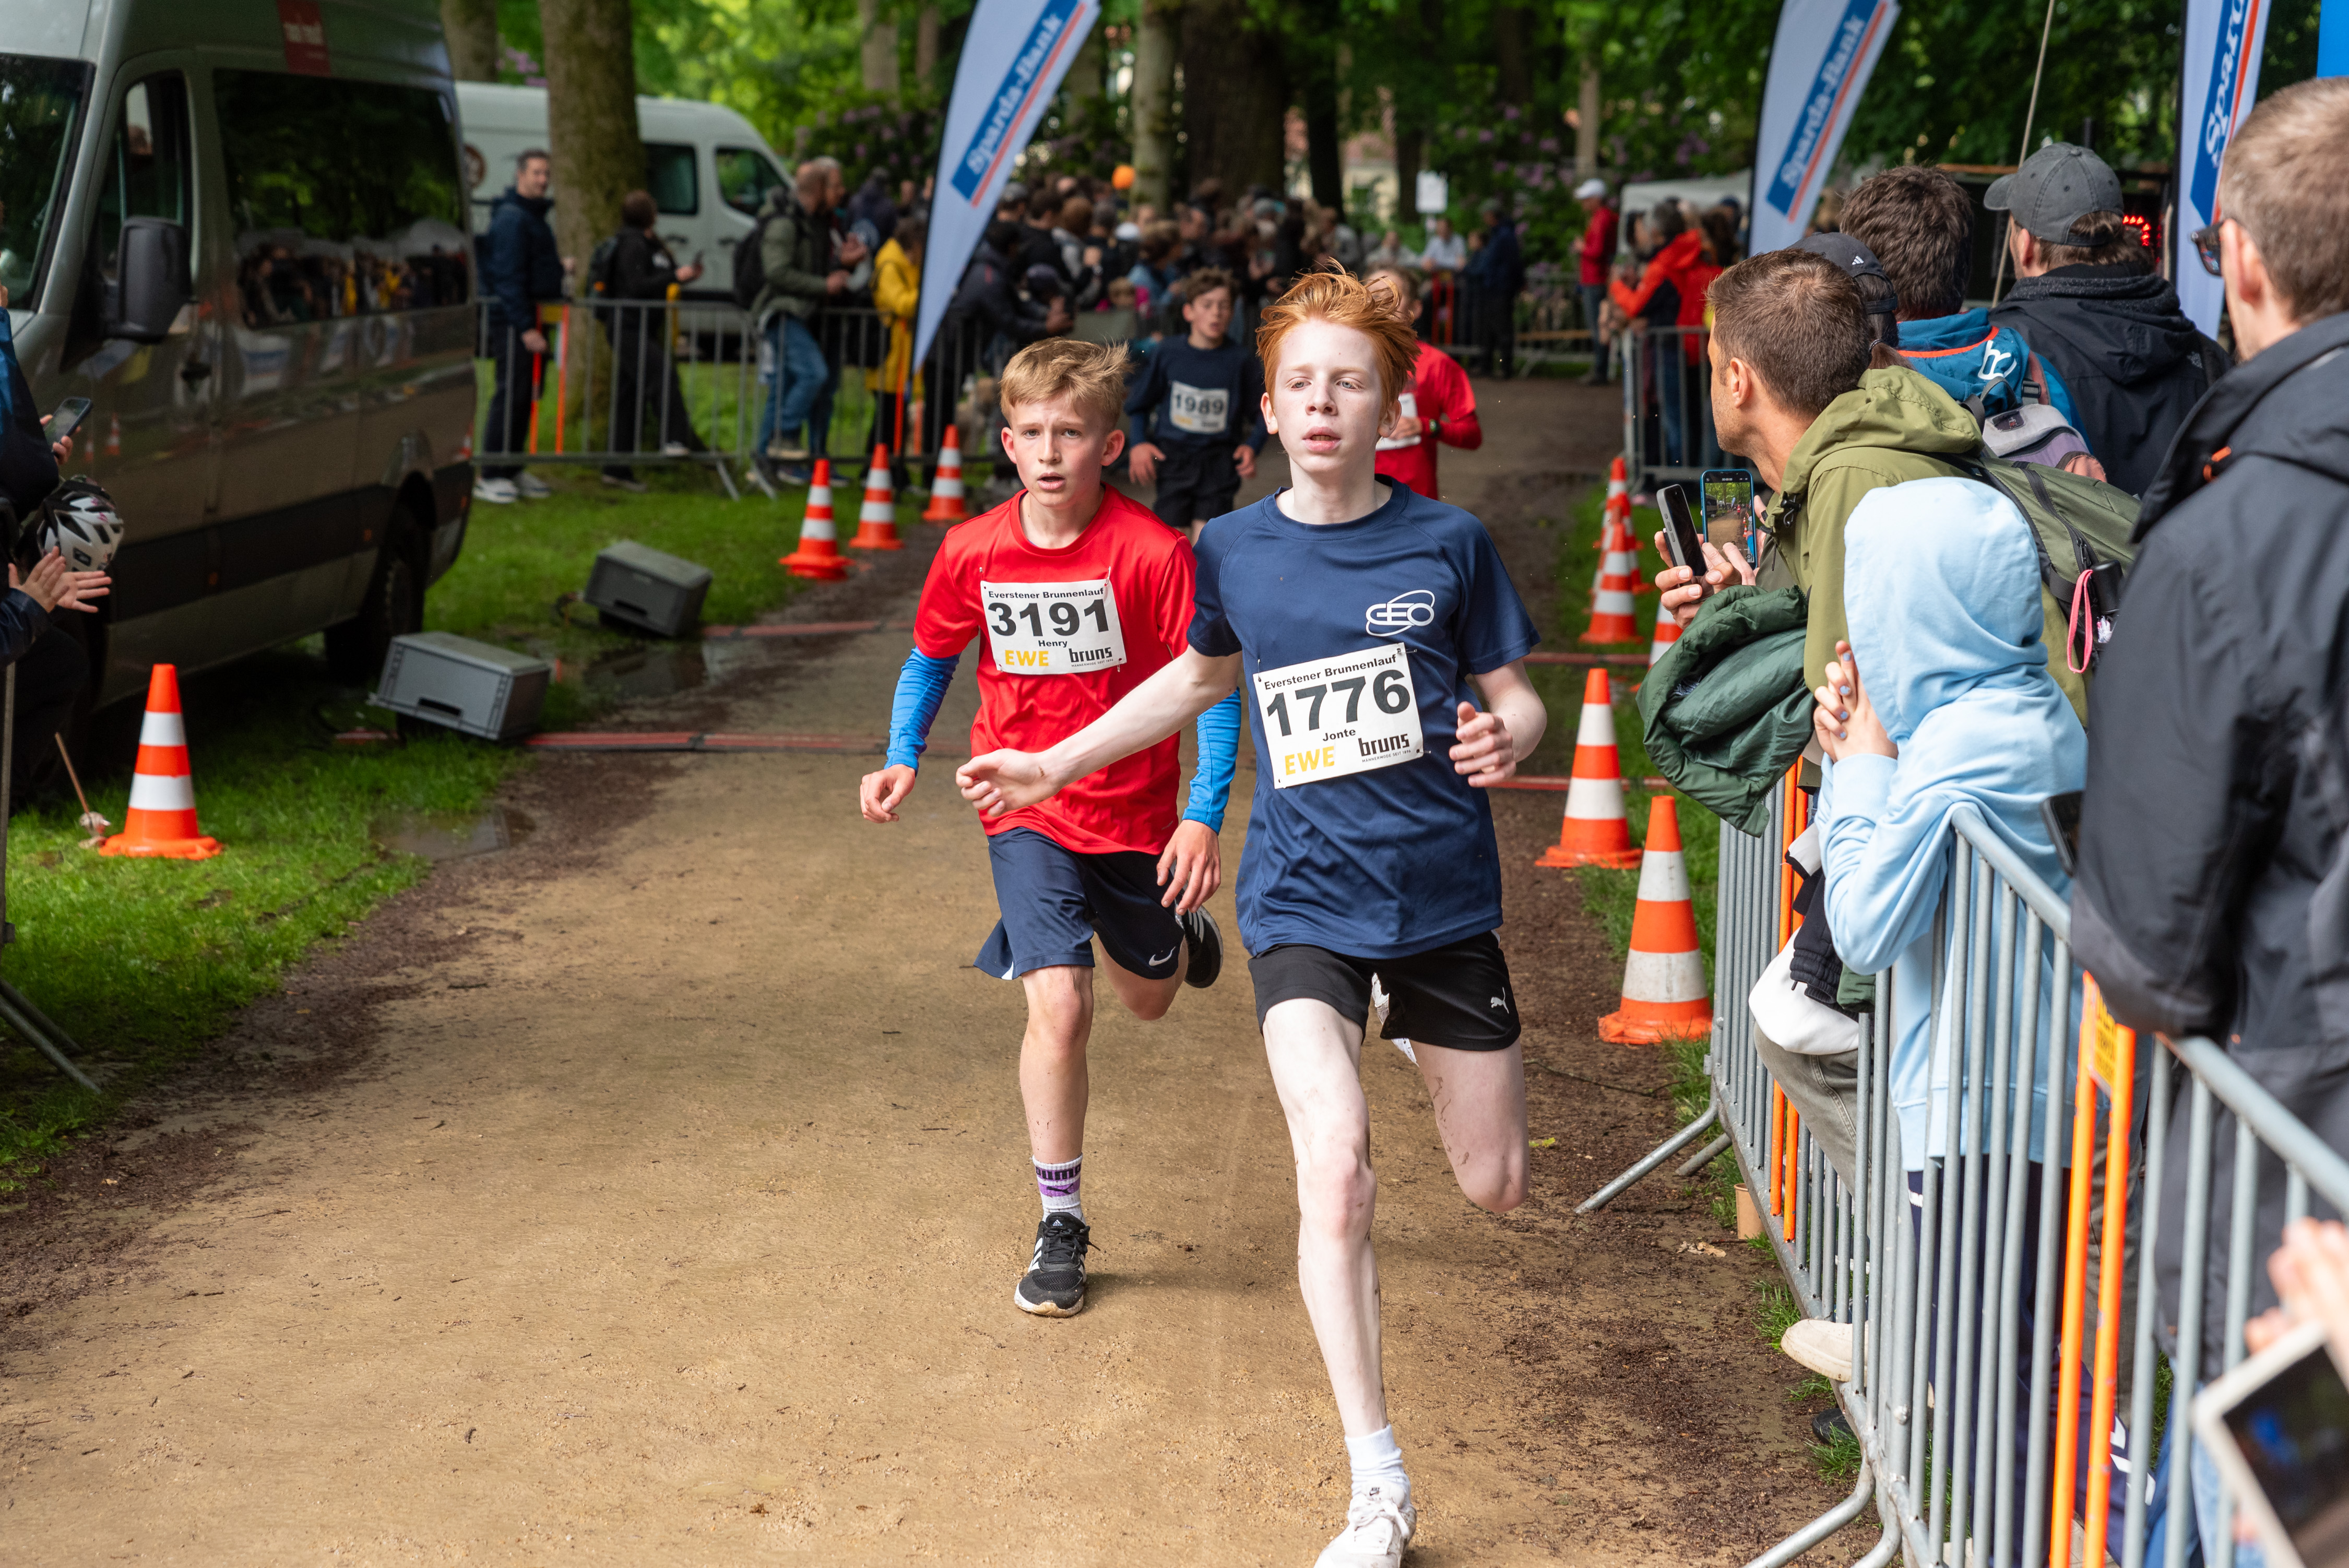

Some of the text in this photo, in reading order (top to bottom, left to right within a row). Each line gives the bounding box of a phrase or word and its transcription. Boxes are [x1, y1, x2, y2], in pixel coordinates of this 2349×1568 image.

[966, 14, 1063, 174] Sparda-Bank
[1780, 15, 1865, 188] Sparda-Bank
[1176, 394, 1224, 415] 1989
[1043, 588, 1104, 599] Brunnenlauf
[988, 599, 1109, 636] 3191
[1005, 650, 1049, 667] EWE
[1069, 647, 1112, 662] bruns
[1264, 654, 1396, 690] Everstener Brunnenlauf
[1267, 669, 1410, 737] 1776
[1323, 729, 1356, 742] Jonte
[1358, 733, 1409, 757] bruns
[1285, 746, 1335, 775] EWE
